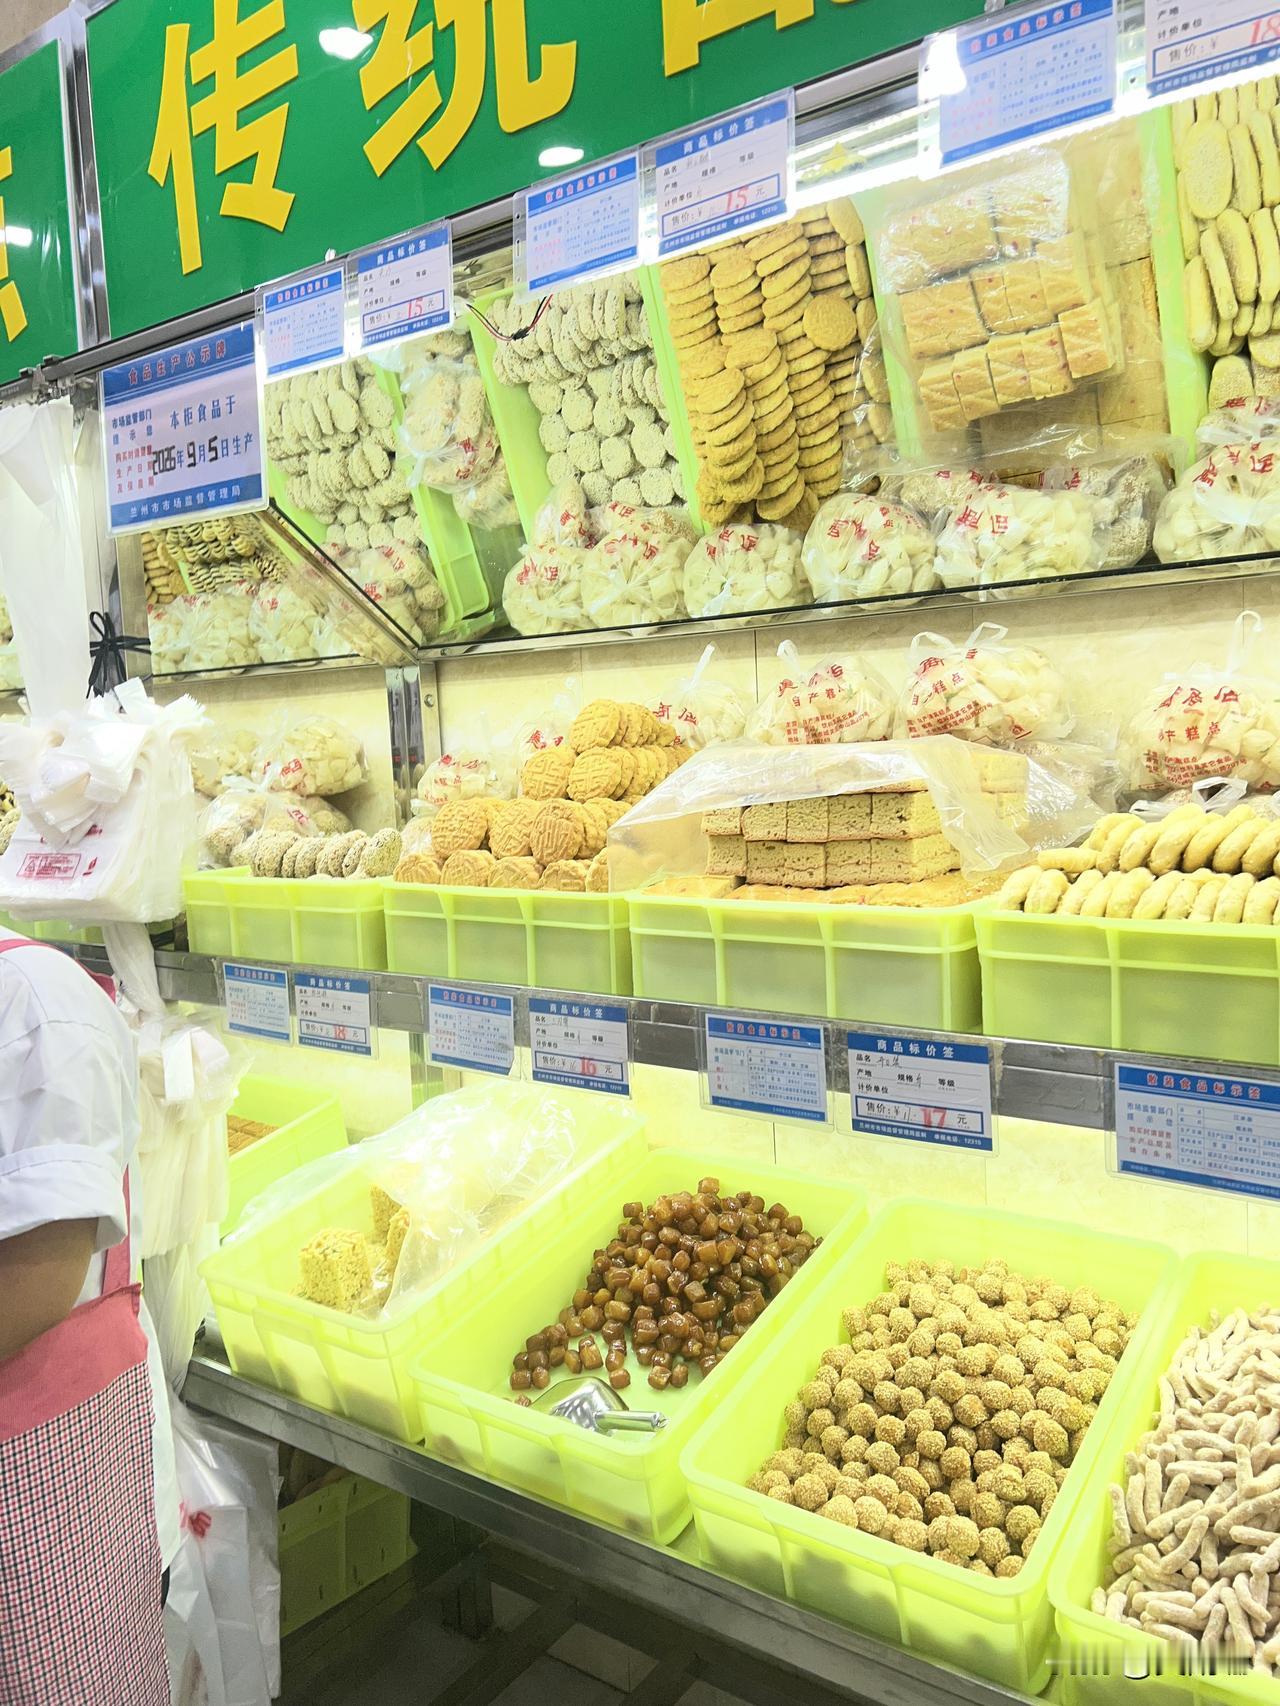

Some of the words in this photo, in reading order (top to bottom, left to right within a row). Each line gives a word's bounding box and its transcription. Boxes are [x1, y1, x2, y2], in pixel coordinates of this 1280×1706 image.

[147, 0, 814, 277] 传统
[683, 117, 755, 154] 商品标价签
[725, 185, 749, 215] 15
[128, 340, 226, 385] 食品生产公示牌
[170, 395, 236, 430] 本柜食品于
[129, 484, 241, 518] 兰州市市场监督管理局
[550, 1003, 603, 1018] 商品标价签
[856, 1054, 871, 1062] 品名
[877, 1039, 954, 1058] 商品标价签
[856, 1068, 872, 1077] 产地
[897, 1074, 913, 1082] 规格
[938, 1078, 955, 1087] 等级
[858, 1084, 888, 1094] 计价单位
[957, 1113, 968, 1125] 元
